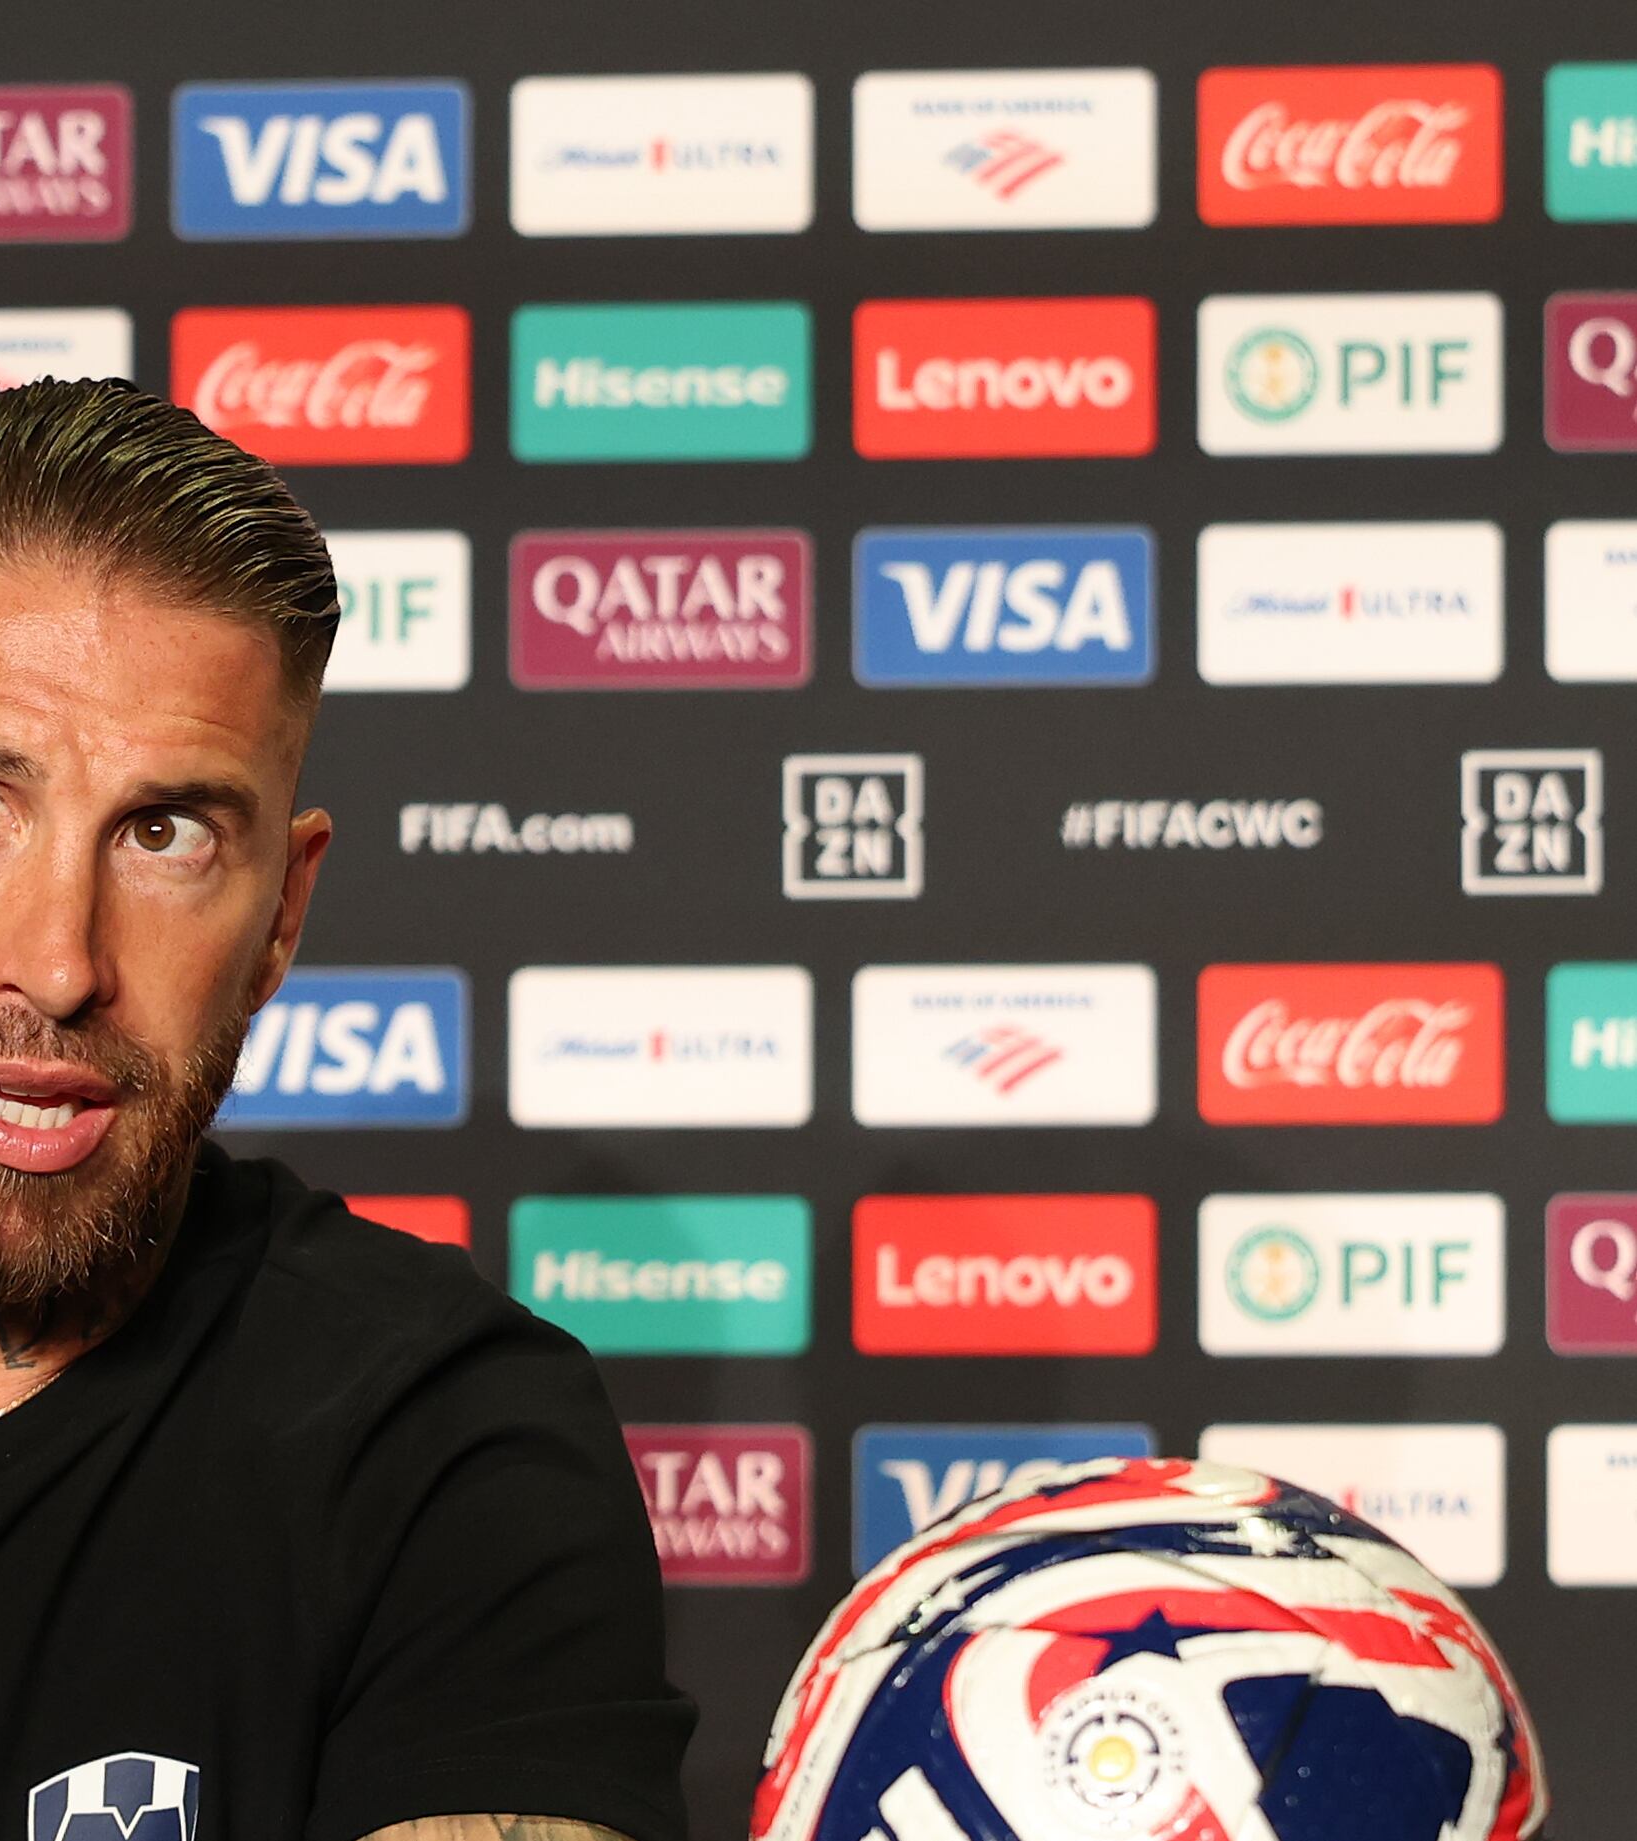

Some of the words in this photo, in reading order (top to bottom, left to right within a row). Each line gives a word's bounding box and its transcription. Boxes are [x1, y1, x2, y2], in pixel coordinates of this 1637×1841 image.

[204, 114, 445, 205] VISA
[535, 360, 787, 407] Hisense
[877, 351, 1132, 410] Lenovo
[1339, 341, 1468, 406] PIF
[532, 554, 787, 636] QATAR
[886, 561, 1130, 652] VISA
[1360, 588, 1469, 617] ULTRA
[595, 622, 791, 664] AIRWAYS
[400, 804, 632, 852] FIFA.com
[1062, 800, 1320, 848] #FIFACWC
[533, 1252, 789, 1301] Hisense
[877, 1246, 1133, 1306] Lenovo
[1339, 1242, 1469, 1306] PIF
[643, 1451, 785, 1517] TAR
